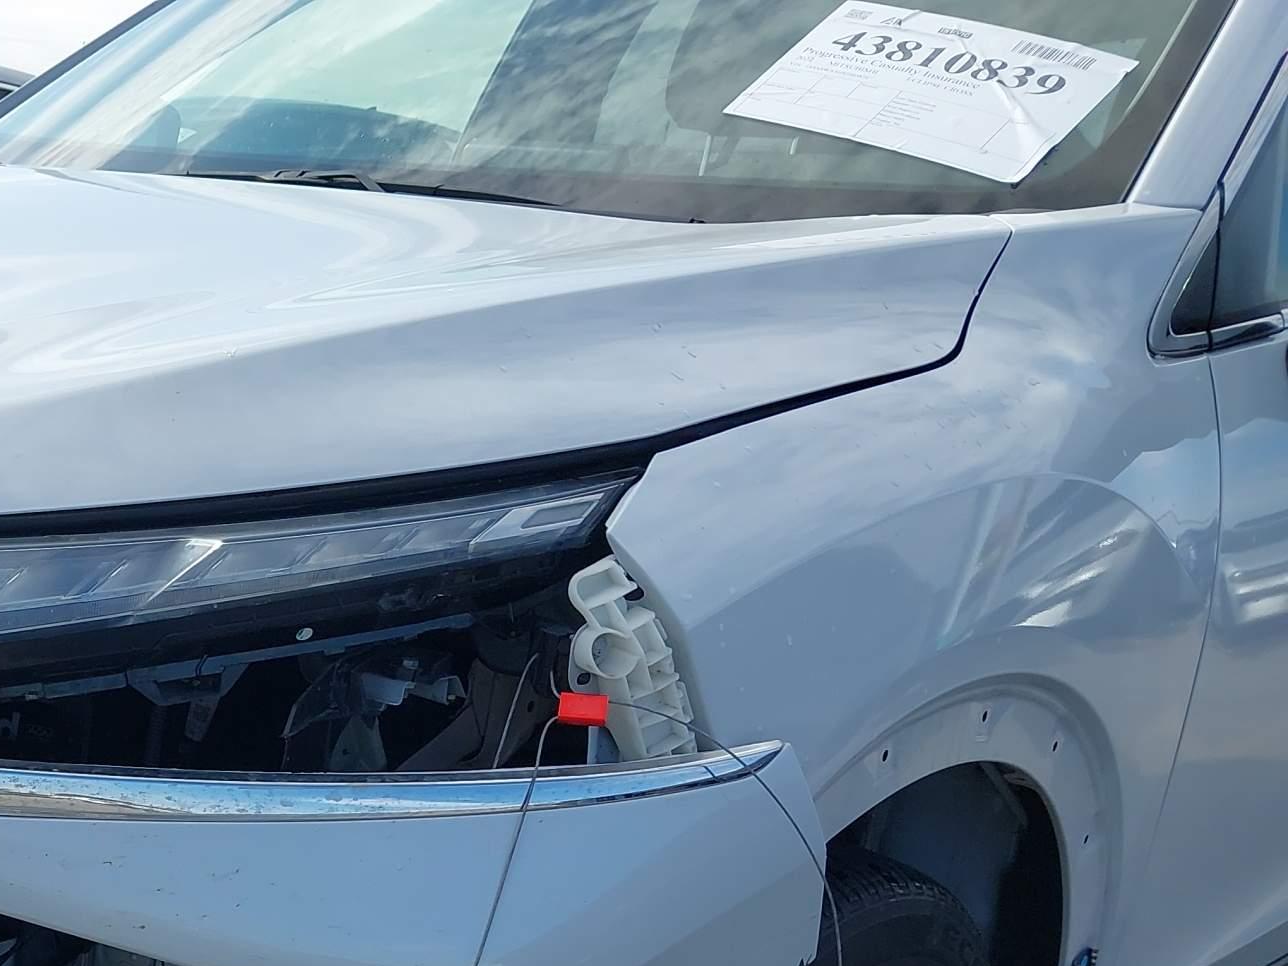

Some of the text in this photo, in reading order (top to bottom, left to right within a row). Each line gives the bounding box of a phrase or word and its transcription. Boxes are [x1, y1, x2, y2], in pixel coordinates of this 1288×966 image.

[803, 47, 869, 64] Progressive
[870, 59, 920, 76] Casualty
[923, 70, 982, 90] Insurance
[831, 31, 1067, 95] 43810839
